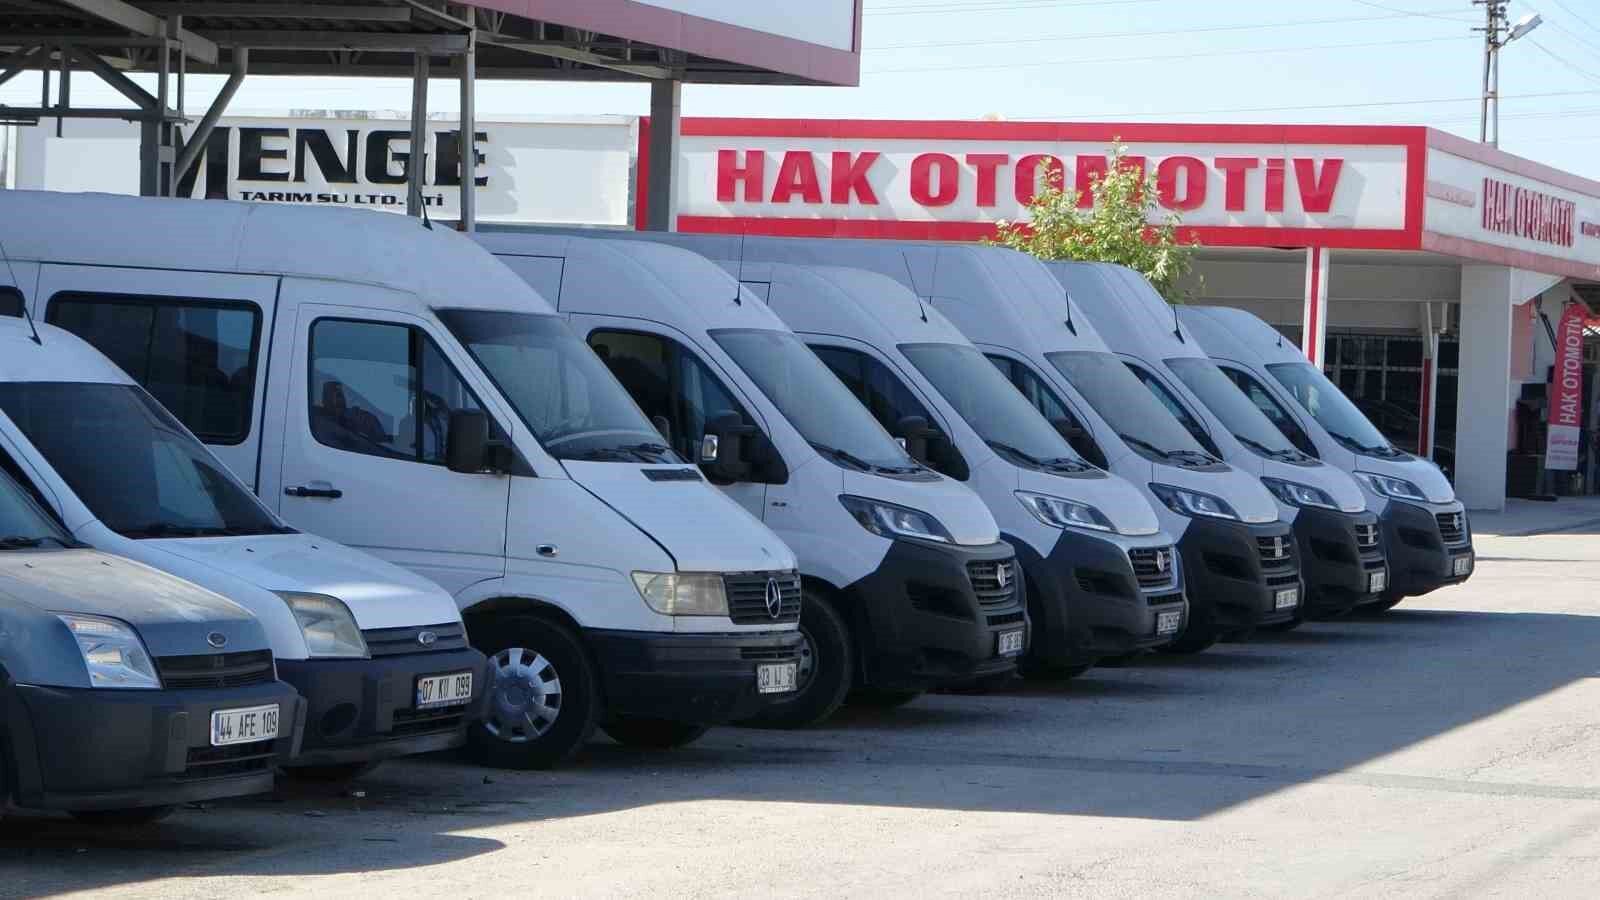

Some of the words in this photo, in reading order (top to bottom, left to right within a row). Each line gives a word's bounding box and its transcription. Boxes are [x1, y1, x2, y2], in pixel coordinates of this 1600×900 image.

[717, 149, 881, 205] HAK
[239, 191, 312, 203] TARIM
[317, 193, 348, 204] SU
[1560, 392, 1577, 424] HAK
[422, 680, 434, 701] 07
[455, 675, 470, 697] 099
[220, 714, 233, 740] 44
[239, 712, 257, 737] AFE
[263, 711, 277, 735] 109
